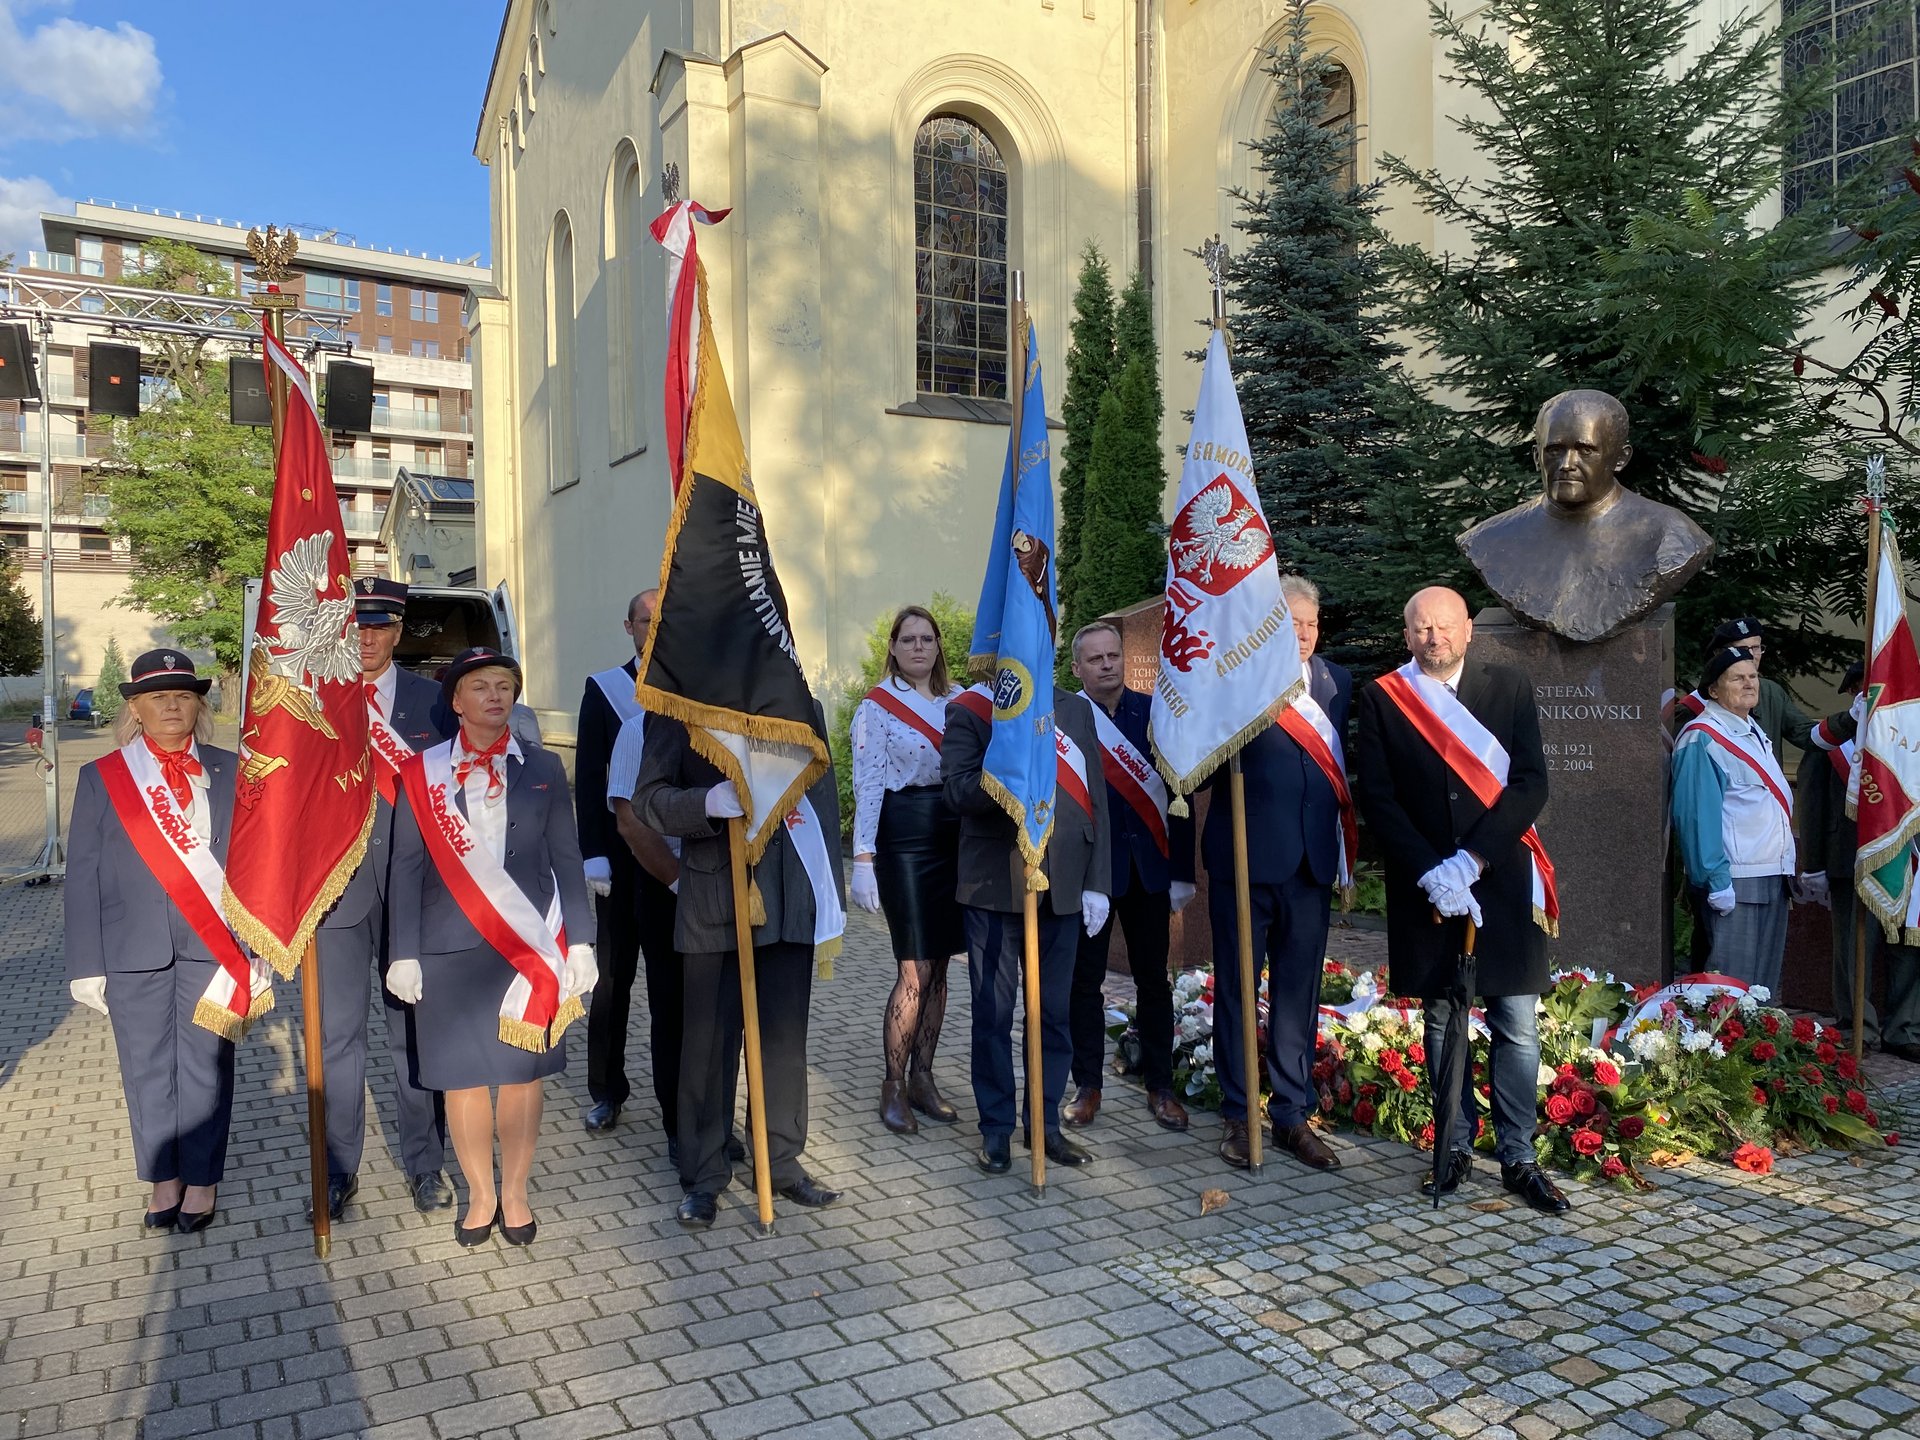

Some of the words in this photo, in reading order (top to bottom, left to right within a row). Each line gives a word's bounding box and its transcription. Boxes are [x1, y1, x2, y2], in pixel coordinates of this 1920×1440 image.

[1132, 655, 1158, 664] TYLKO
[1133, 681, 1156, 691] DUC
[1536, 685, 1596, 698] STEFAN
[1538, 704, 1642, 720] NIKOWSKI
[1563, 744, 1594, 756] 1921
[1562, 759, 1594, 771] 2004
